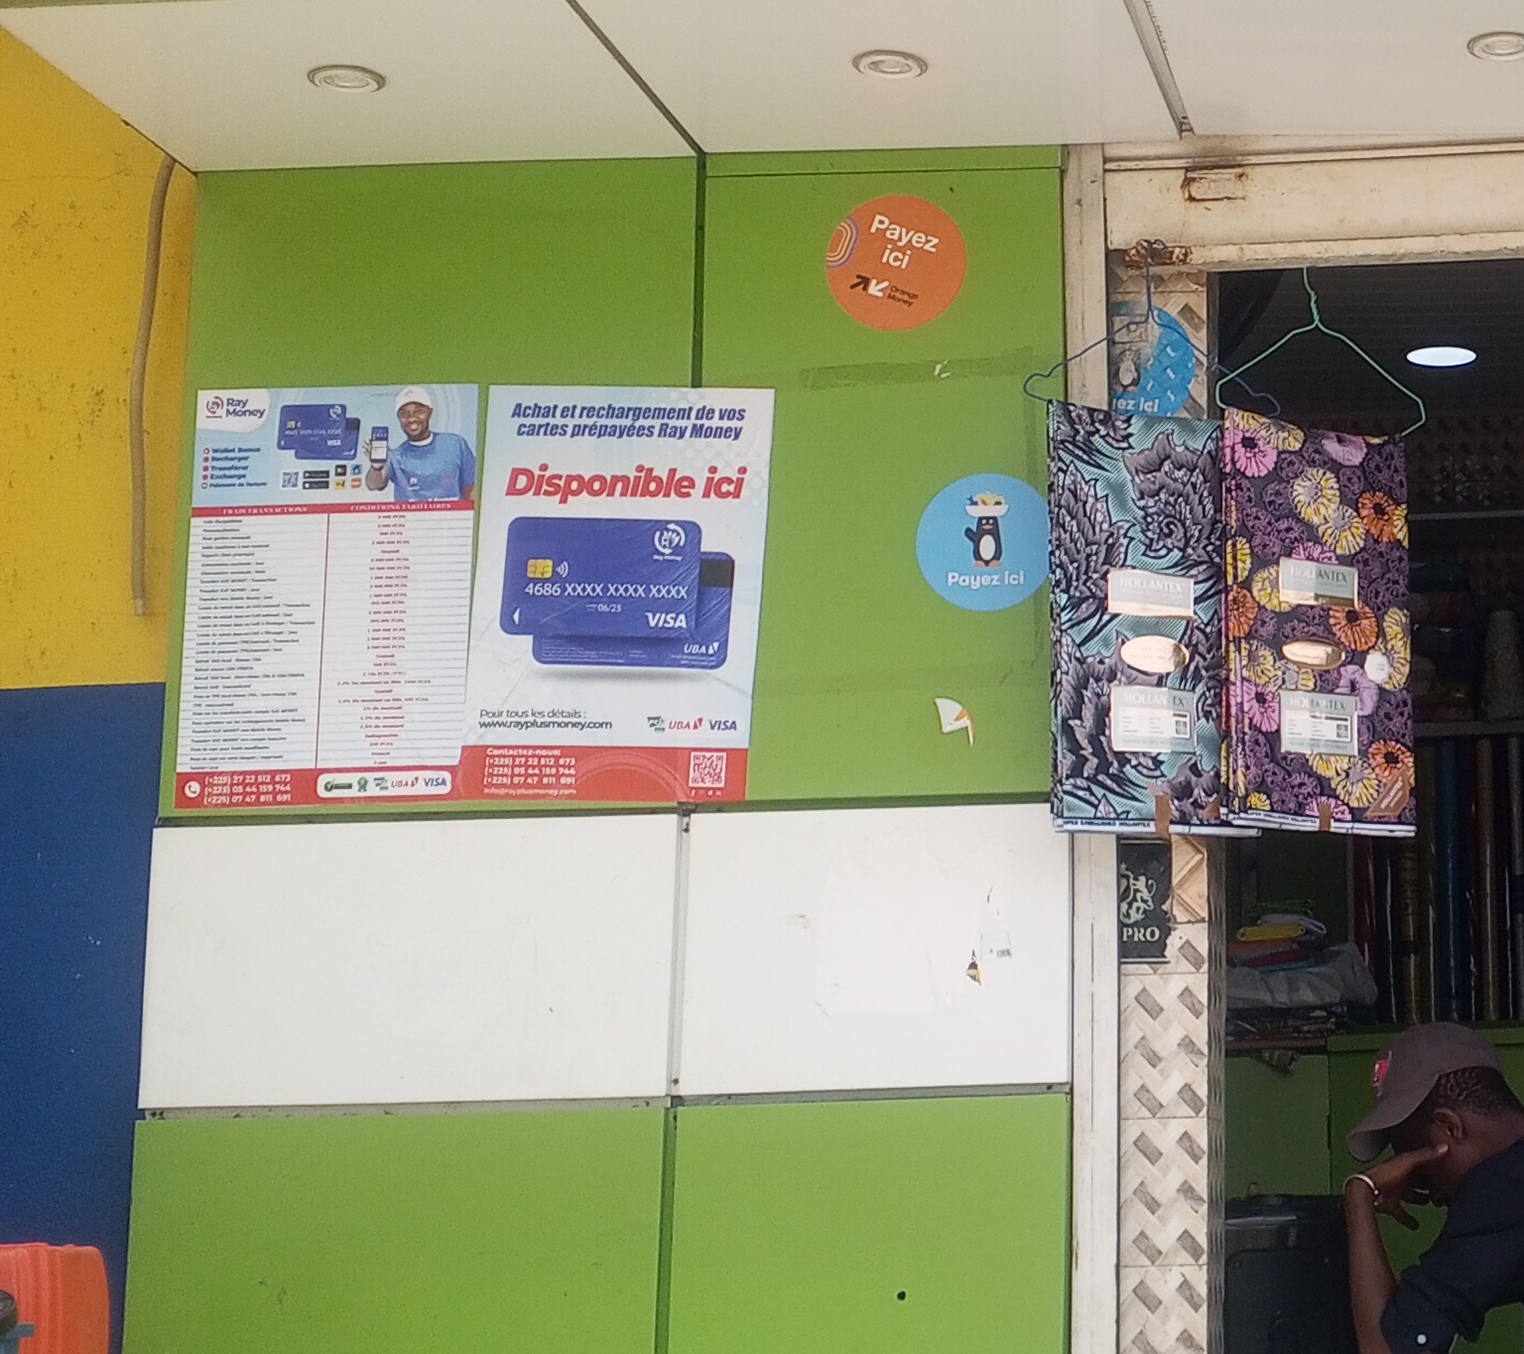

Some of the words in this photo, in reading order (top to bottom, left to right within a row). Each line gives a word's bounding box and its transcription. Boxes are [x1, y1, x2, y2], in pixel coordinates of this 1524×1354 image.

[869, 213, 940, 253] Payez
[881, 244, 912, 270] ici
[887, 292, 914, 308] Money
[890, 285, 920, 300] Orange
[226, 397, 249, 409] Ray
[225, 408, 266, 419] Money
[511, 402, 559, 419] Achat
[560, 403, 577, 419] et
[578, 403, 693, 421] rechargement
[695, 405, 715, 421] de
[718, 408, 747, 422] vos
[516, 421, 568, 437] cartes
[569, 419, 655, 439] prépayées
[657, 422, 689, 441] Ray
[689, 423, 744, 442] Money
[505, 463, 696, 505] Disponible
[701, 465, 748, 499] ici
[946, 571, 1001, 591] Payez
[1290, 565, 1349, 584] HOLLANTEX
[524, 582, 562, 597] 4686
[564, 583, 603, 597] XXXX
[606, 583, 646, 598] XXXX
[648, 585, 689, 600] XXXX
[1120, 576, 1184, 593] HOLLANTEX
[644, 612, 688, 629] VISA
[1124, 692, 1185, 708] HOLLANEX
[480, 708, 504, 719] Pour
[506, 708, 529, 719] tous
[531, 708, 546, 719] les
[546, 708, 582, 719] détails
[478, 719, 613, 731] www.rayplusmoney.com
[708, 720, 737, 731] VISA
[423, 777, 447, 787] VISA
[1121, 927, 1160, 943] PRO
